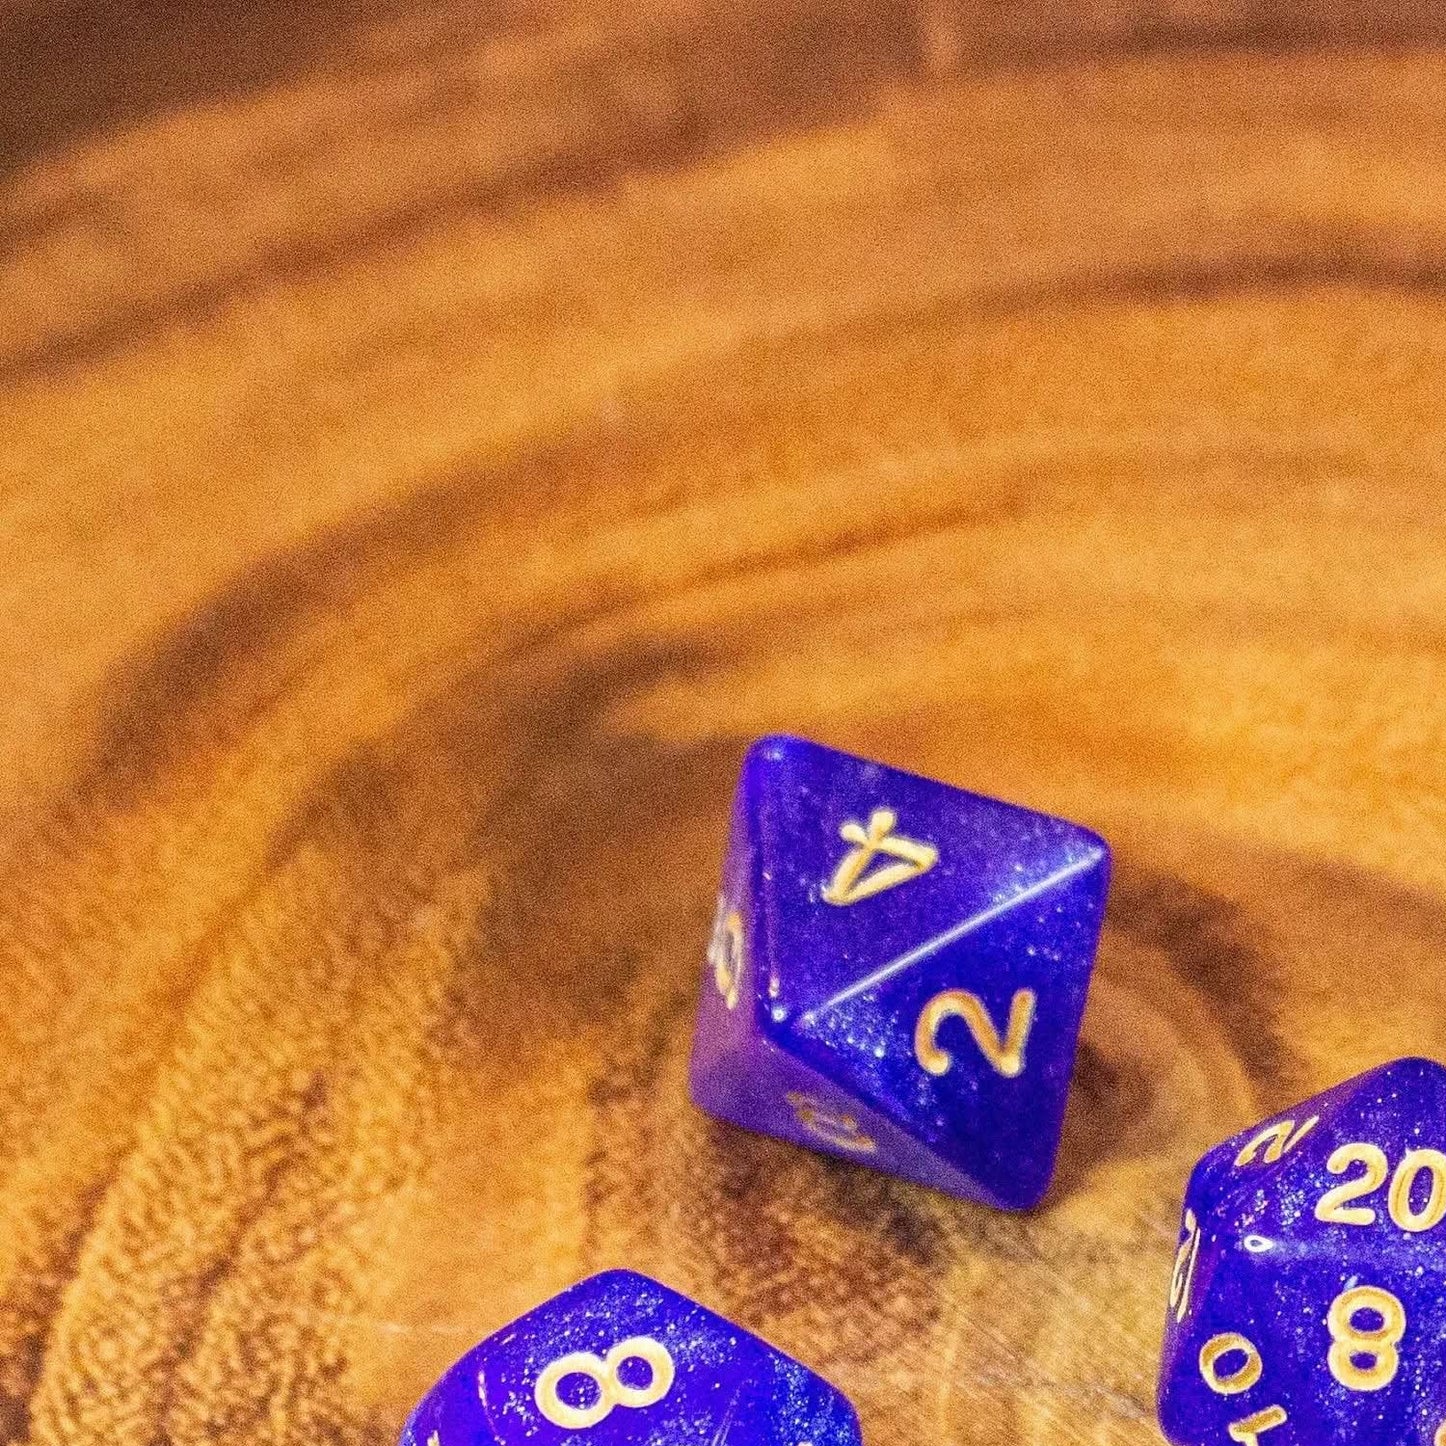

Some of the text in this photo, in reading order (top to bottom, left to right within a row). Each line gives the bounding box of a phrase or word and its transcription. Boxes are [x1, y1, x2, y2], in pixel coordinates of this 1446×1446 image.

[822, 808, 939, 906] 4
[914, 987, 1036, 1079] 2
[1233, 1115, 1320, 1167] 2
[534, 1335, 676, 1430] 8
[1326, 1285, 1407, 1392] 8
